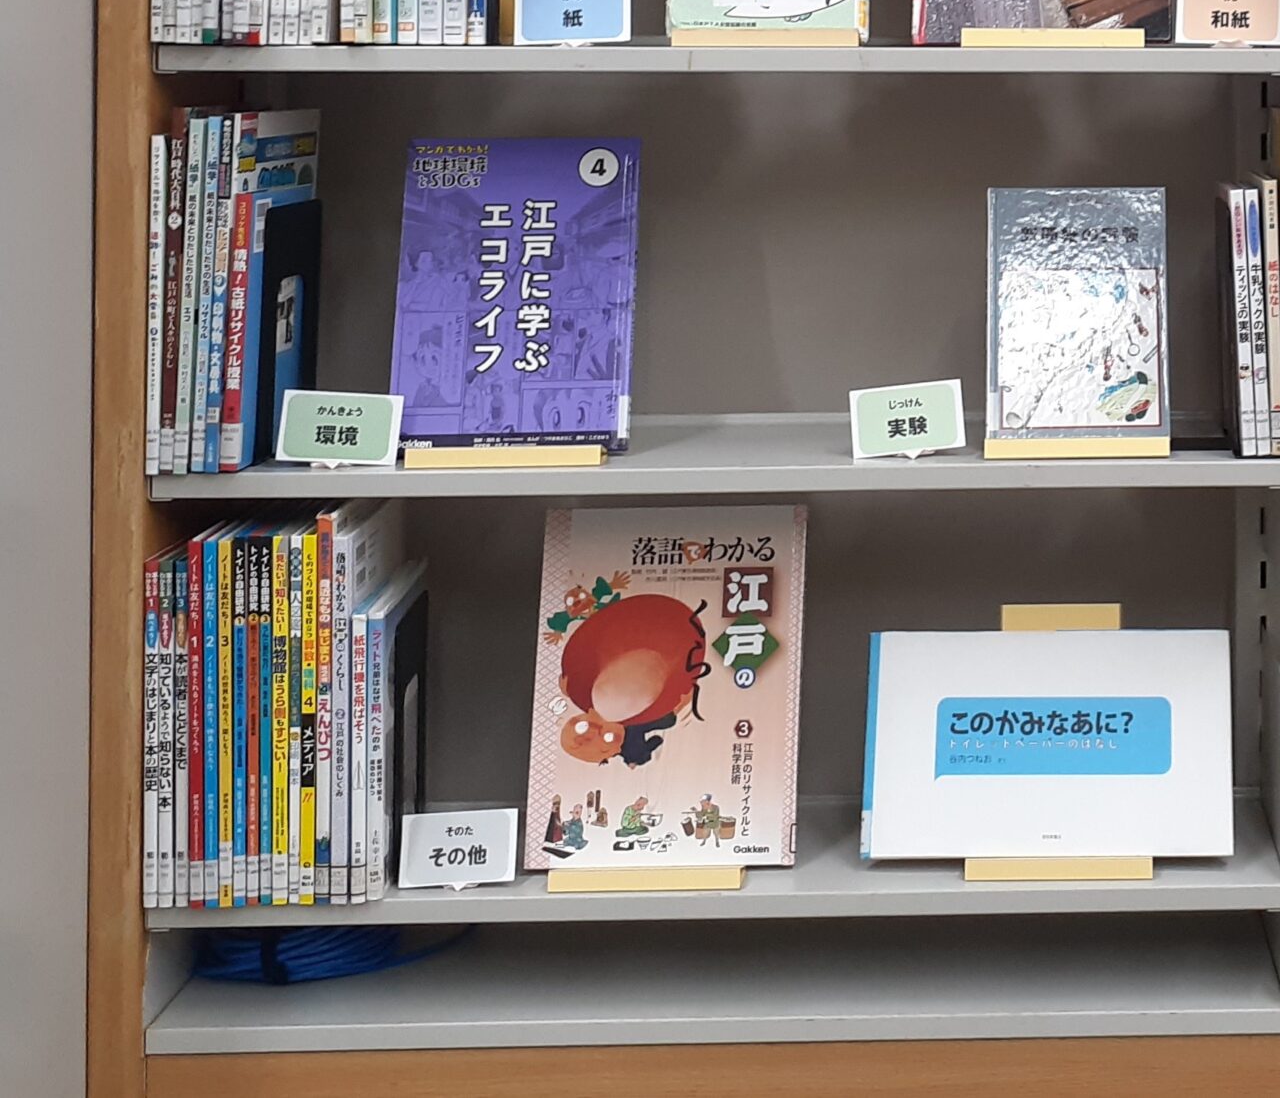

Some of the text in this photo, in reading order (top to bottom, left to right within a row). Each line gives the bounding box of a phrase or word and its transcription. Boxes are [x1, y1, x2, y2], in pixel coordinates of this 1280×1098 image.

[562, 9, 583, 28] 紙
[1211, 9, 1250, 29] 和紙
[413, 156, 488, 173] 地球環境
[418, 173, 481, 189] とSDGs
[590, 158, 607, 177] 4
[183, 307, 192, 322] エコ
[473, 203, 512, 373] エコライフ
[514, 199, 557, 372] 江戸に学ぶ
[1235, 265, 1250, 343] ティッシュの実験
[1250, 264, 1266, 354] 牛乳パックの実験
[1268, 260, 1279, 318] 紙のはなし
[200, 304, 208, 339] リサイクル
[226, 287, 246, 390] 古紙リサイクル授業
[317, 405, 363, 417] かんきょう
[887, 415, 928, 438] 実験
[888, 399, 923, 410] じっけん
[315, 425, 359, 446] 環境
[250, 545, 259, 612] トイレの自由研究
[261, 546, 270, 613] トイレの自由研究
[631, 536, 776, 565] 落語でわかる
[190, 555, 199, 647] ノートは友だち! 1
[205, 555, 214, 647] ノートは友だち! 2
[221, 555, 229, 647] ノートは友だち! 3
[235, 548, 244, 615] トイレの自由研究
[724, 571, 770, 688] 江戸の
[353, 635, 365, 744] 紙飛行機を飛ばそう
[685, 599, 711, 722] くらし
[175, 653, 188, 770] 本が読者にとどくまで
[304, 697, 313, 708] 4
[370, 631, 382, 752] ライト兄弟はなぜ飛べたのか
[145, 653, 158, 792] 文字のはじまりと本の歴史
[158, 653, 172, 813] 知っているようで知らない「本」
[302, 727, 314, 776] メディア
[317, 698, 331, 761] えんぴつ
[737, 722, 750, 736] 3
[949, 710, 1134, 736] このかみなあに?
[730, 743, 742, 785] 科学技術
[740, 743, 754, 838] 江戸のリサイクルと
[429, 844, 487, 867] その他
[445, 826, 474, 837] そのた
[733, 844, 770, 855] Gakken
